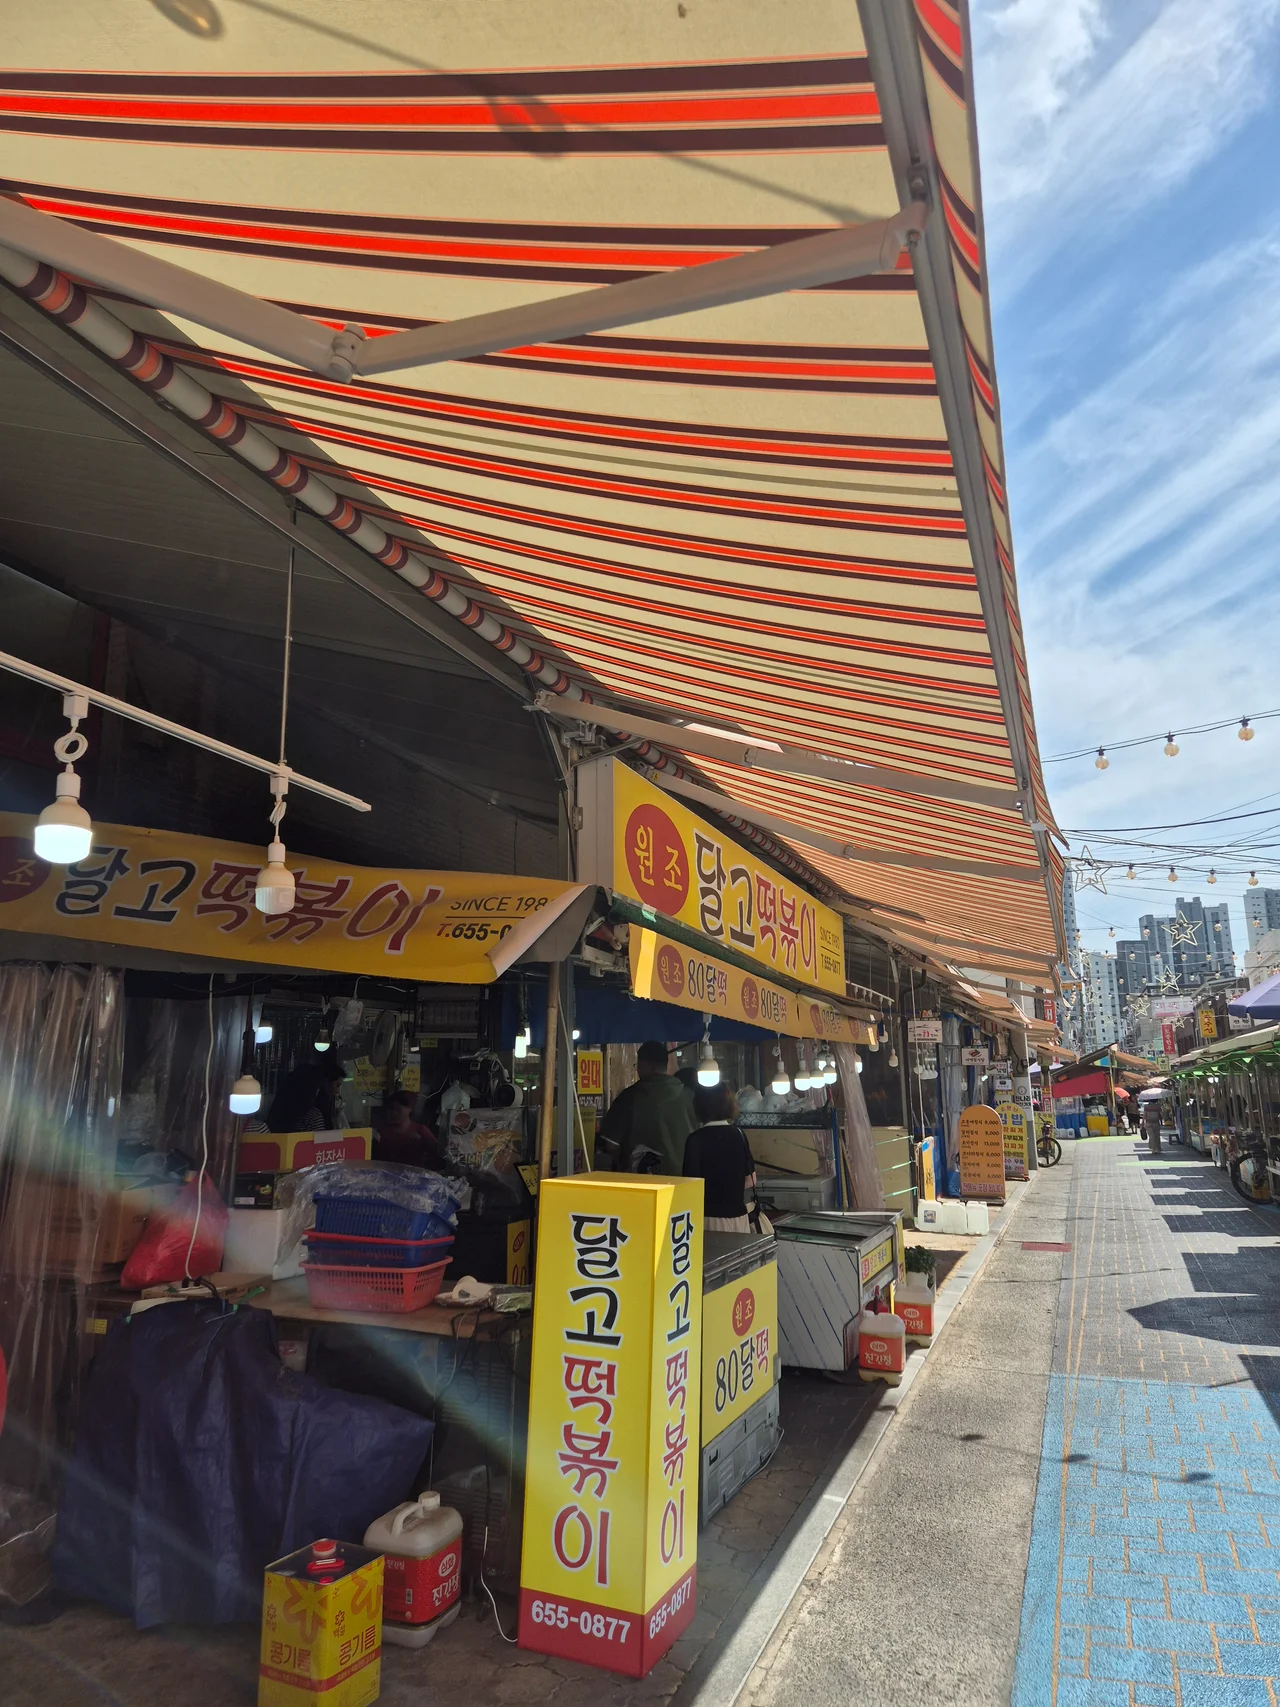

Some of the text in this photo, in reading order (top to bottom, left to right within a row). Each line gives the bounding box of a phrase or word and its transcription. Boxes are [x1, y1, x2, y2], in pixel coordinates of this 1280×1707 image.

[56, 845, 443, 952] 달고떡볶이
[450, 896, 555, 913] SINCE 198
[633, 824, 819, 982] 원조 달고떡볶이
[820, 926, 832, 945] SINCE
[660, 955, 728, 1007] 원조 80달떡
[743, 985, 758, 1009] 원조
[580, 1059, 601, 1089] 임대
[978, 1183, 988, 1193] 포장
[735, 1298, 753, 1328] 원조
[715, 1328, 769, 1412] 80달떡
[864, 1352, 893, 1366] 진간장
[554, 1213, 630, 1586] 달고떡볶이
[660, 1212, 694, 1564] 달고떡볶이
[432, 1571, 460, 1607] 진간장
[650, 1576, 693, 1640] 655-0877
[531, 1600, 631, 1643] 655-0877
[270, 1640, 312, 1673] 콩기름
[339, 1624, 377, 1666] 콩기름
